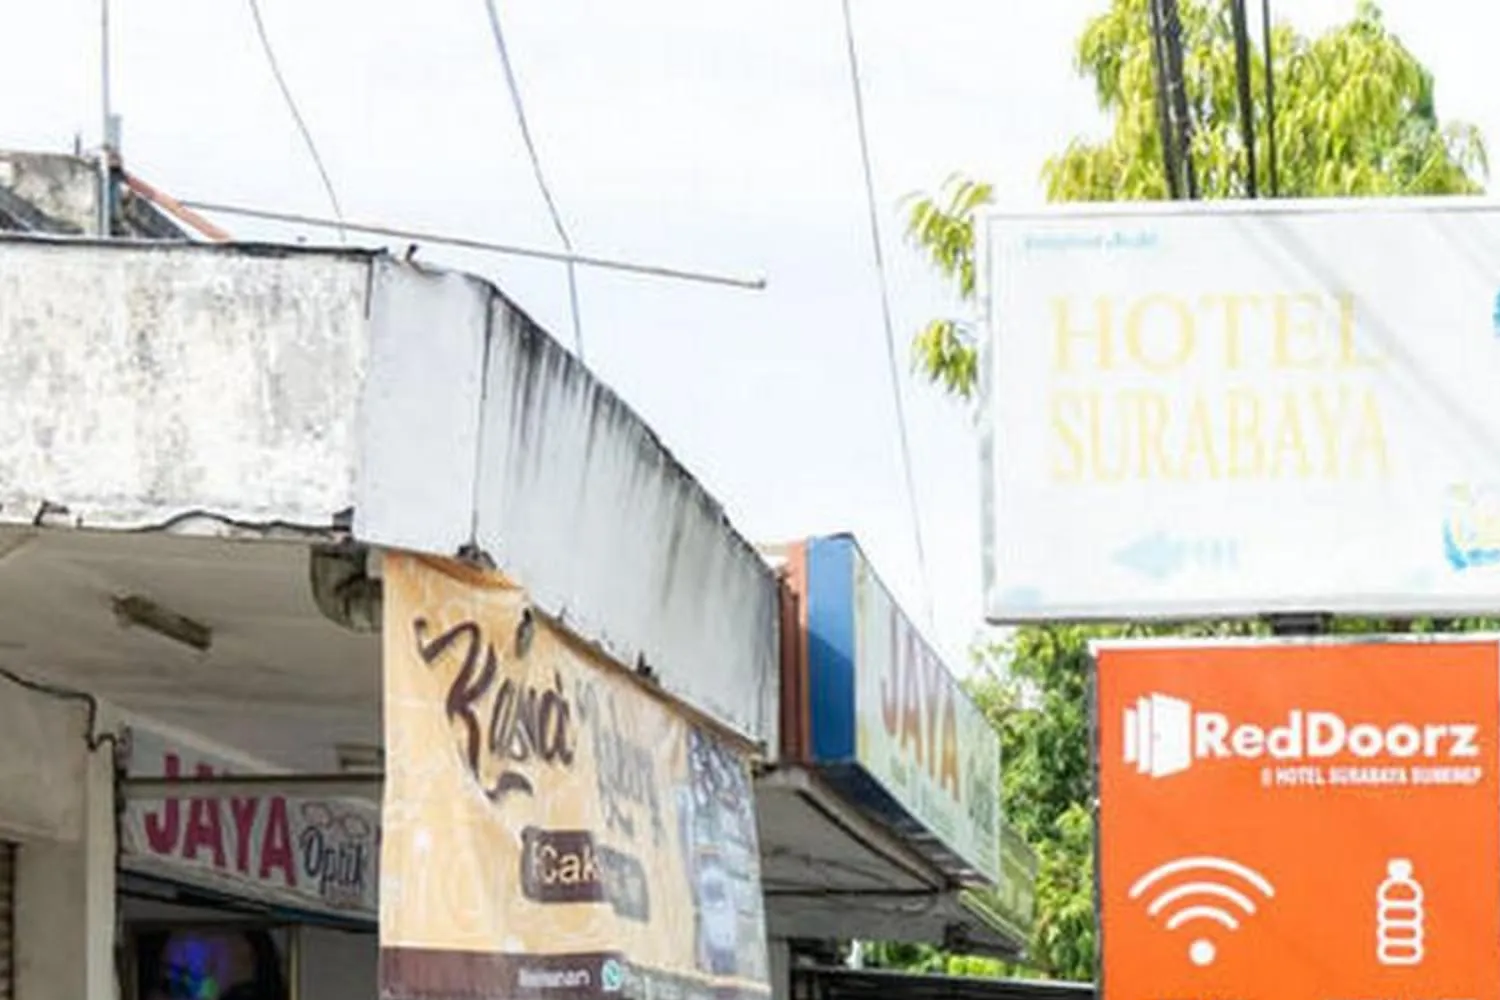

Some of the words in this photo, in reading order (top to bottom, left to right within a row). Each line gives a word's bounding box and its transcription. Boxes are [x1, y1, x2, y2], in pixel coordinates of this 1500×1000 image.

[1046, 289, 1388, 374] HOTEL
[1046, 384, 1390, 484] SURABAYA
[879, 602, 961, 803] JAYA
[1193, 709, 1480, 760] RedDoorz
[144, 752, 297, 888] JAYA
